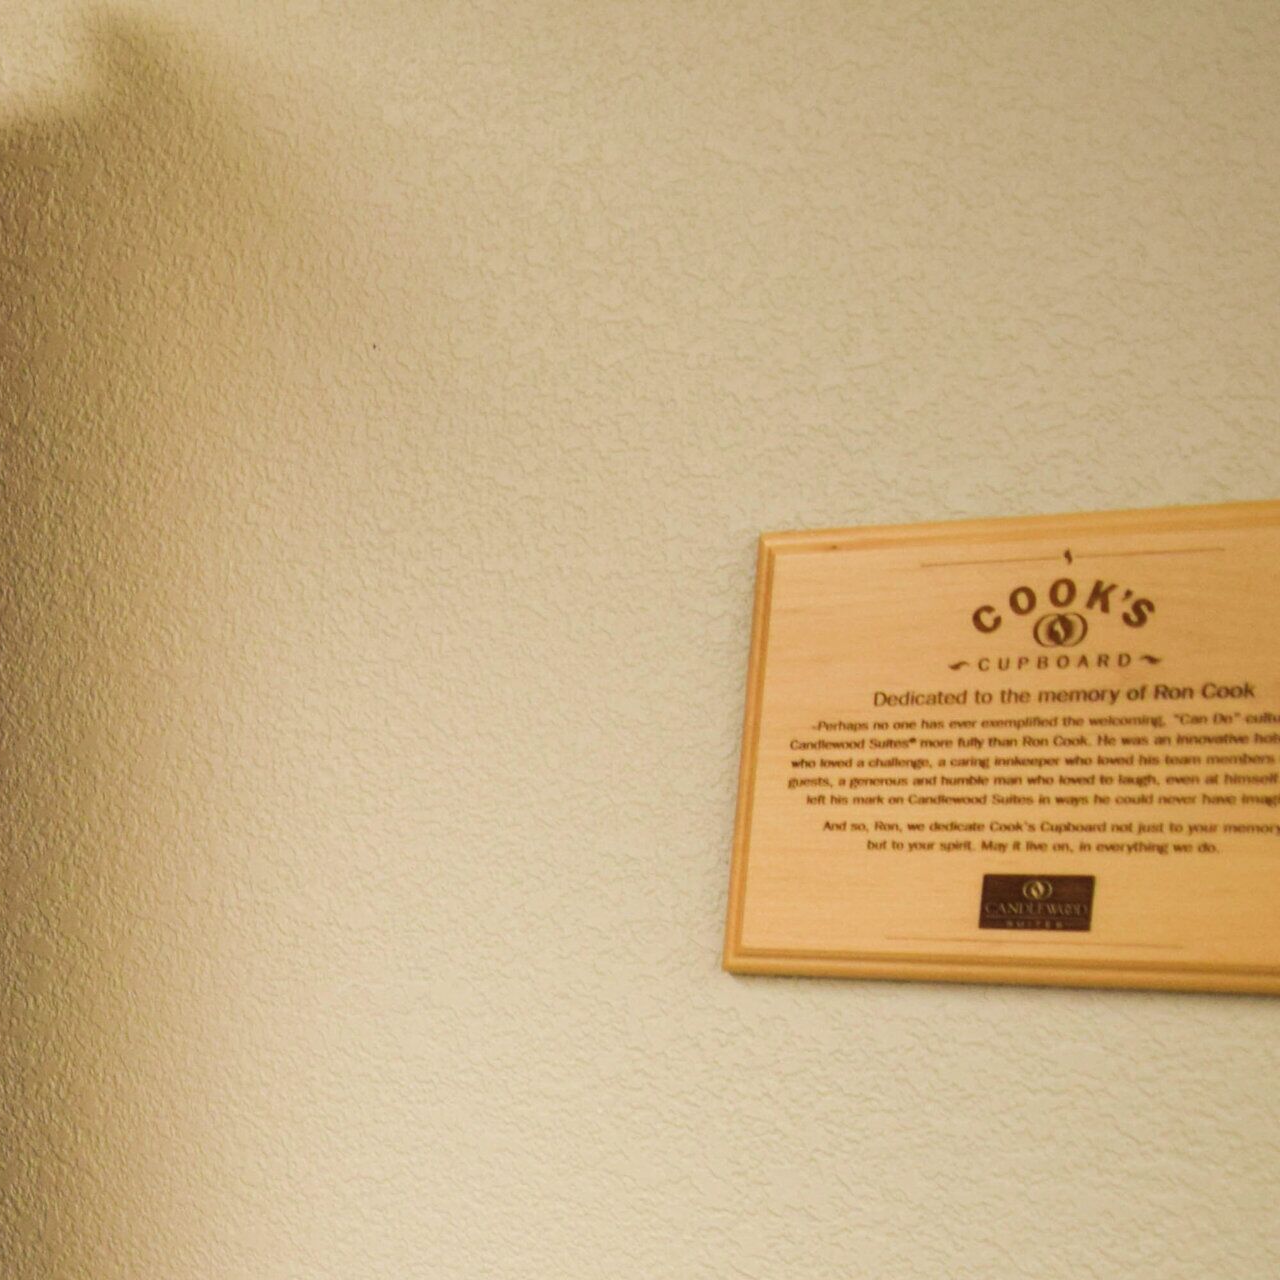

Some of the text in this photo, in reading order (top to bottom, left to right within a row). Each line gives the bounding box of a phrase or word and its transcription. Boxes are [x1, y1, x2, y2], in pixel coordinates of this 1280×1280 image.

[972, 577, 1155, 633] COOK'S
[978, 653, 1131, 672] CUPBOARD
[874, 683, 1255, 706] Dedicated to the memory of Ron Cook
[873, 721, 888, 730] no
[893, 720, 916, 730] one
[921, 719, 944, 729] has
[949, 719, 976, 729] ever
[981, 716, 1058, 729] exemplified
[1063, 716, 1084, 726] the
[790, 739, 864, 750] Candlewood
[920, 739, 953, 748] more
[958, 737, 983, 748] fully
[988, 737, 1018, 747] than
[1023, 736, 1049, 747] Ron
[1097, 735, 1116, 746] He
[1121, 736, 1148, 745] was
[1155, 736, 1171, 745] an
[1176, 733, 1248, 744] innovative
